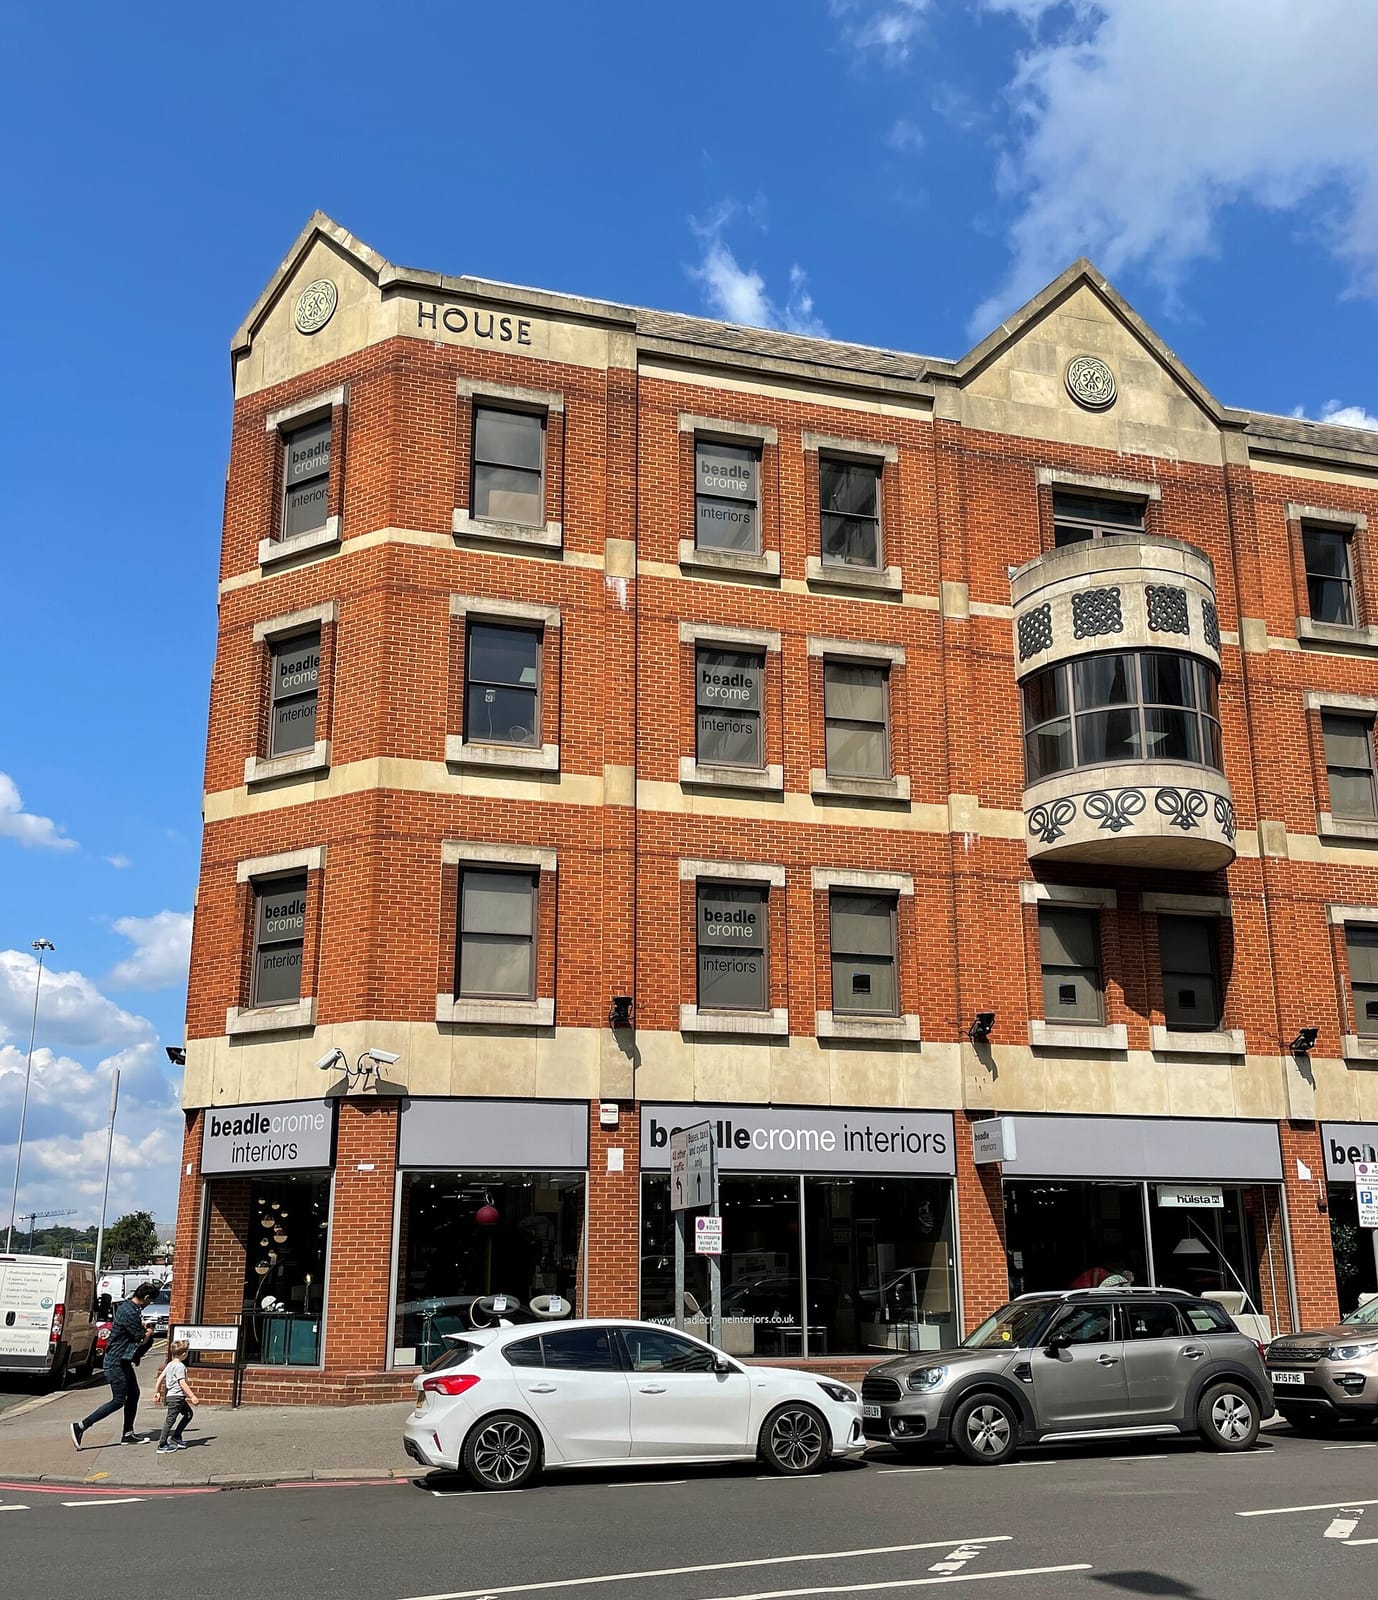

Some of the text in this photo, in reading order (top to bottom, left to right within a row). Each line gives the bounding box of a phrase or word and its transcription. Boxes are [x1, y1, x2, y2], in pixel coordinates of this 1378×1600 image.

[417, 301, 532, 346] HOUSE
[292, 441, 331, 464] beadle
[294, 454, 329, 474] crome
[701, 460, 750, 479] beadle
[704, 475, 748, 491] crome
[701, 505, 750, 523] interiors
[281, 654, 320, 676] beadle
[282, 670, 318, 688] crome
[702, 670, 753, 688] beadle
[706, 686, 750, 700] crome
[701, 717, 753, 734] interiors
[265, 900, 306, 918] beadle
[704, 907, 756, 924] beadle
[266, 916, 304, 932] crome
[707, 924, 753, 938] crome
[263, 953, 302, 969] interior
[703, 957, 757, 973] interiors
[844, 1124, 946, 1154] interiors
[231, 1139, 298, 1163] interiors
[1177, 1194, 1211, 1203] hülsta
[208, 1331, 233, 1339] STREET
